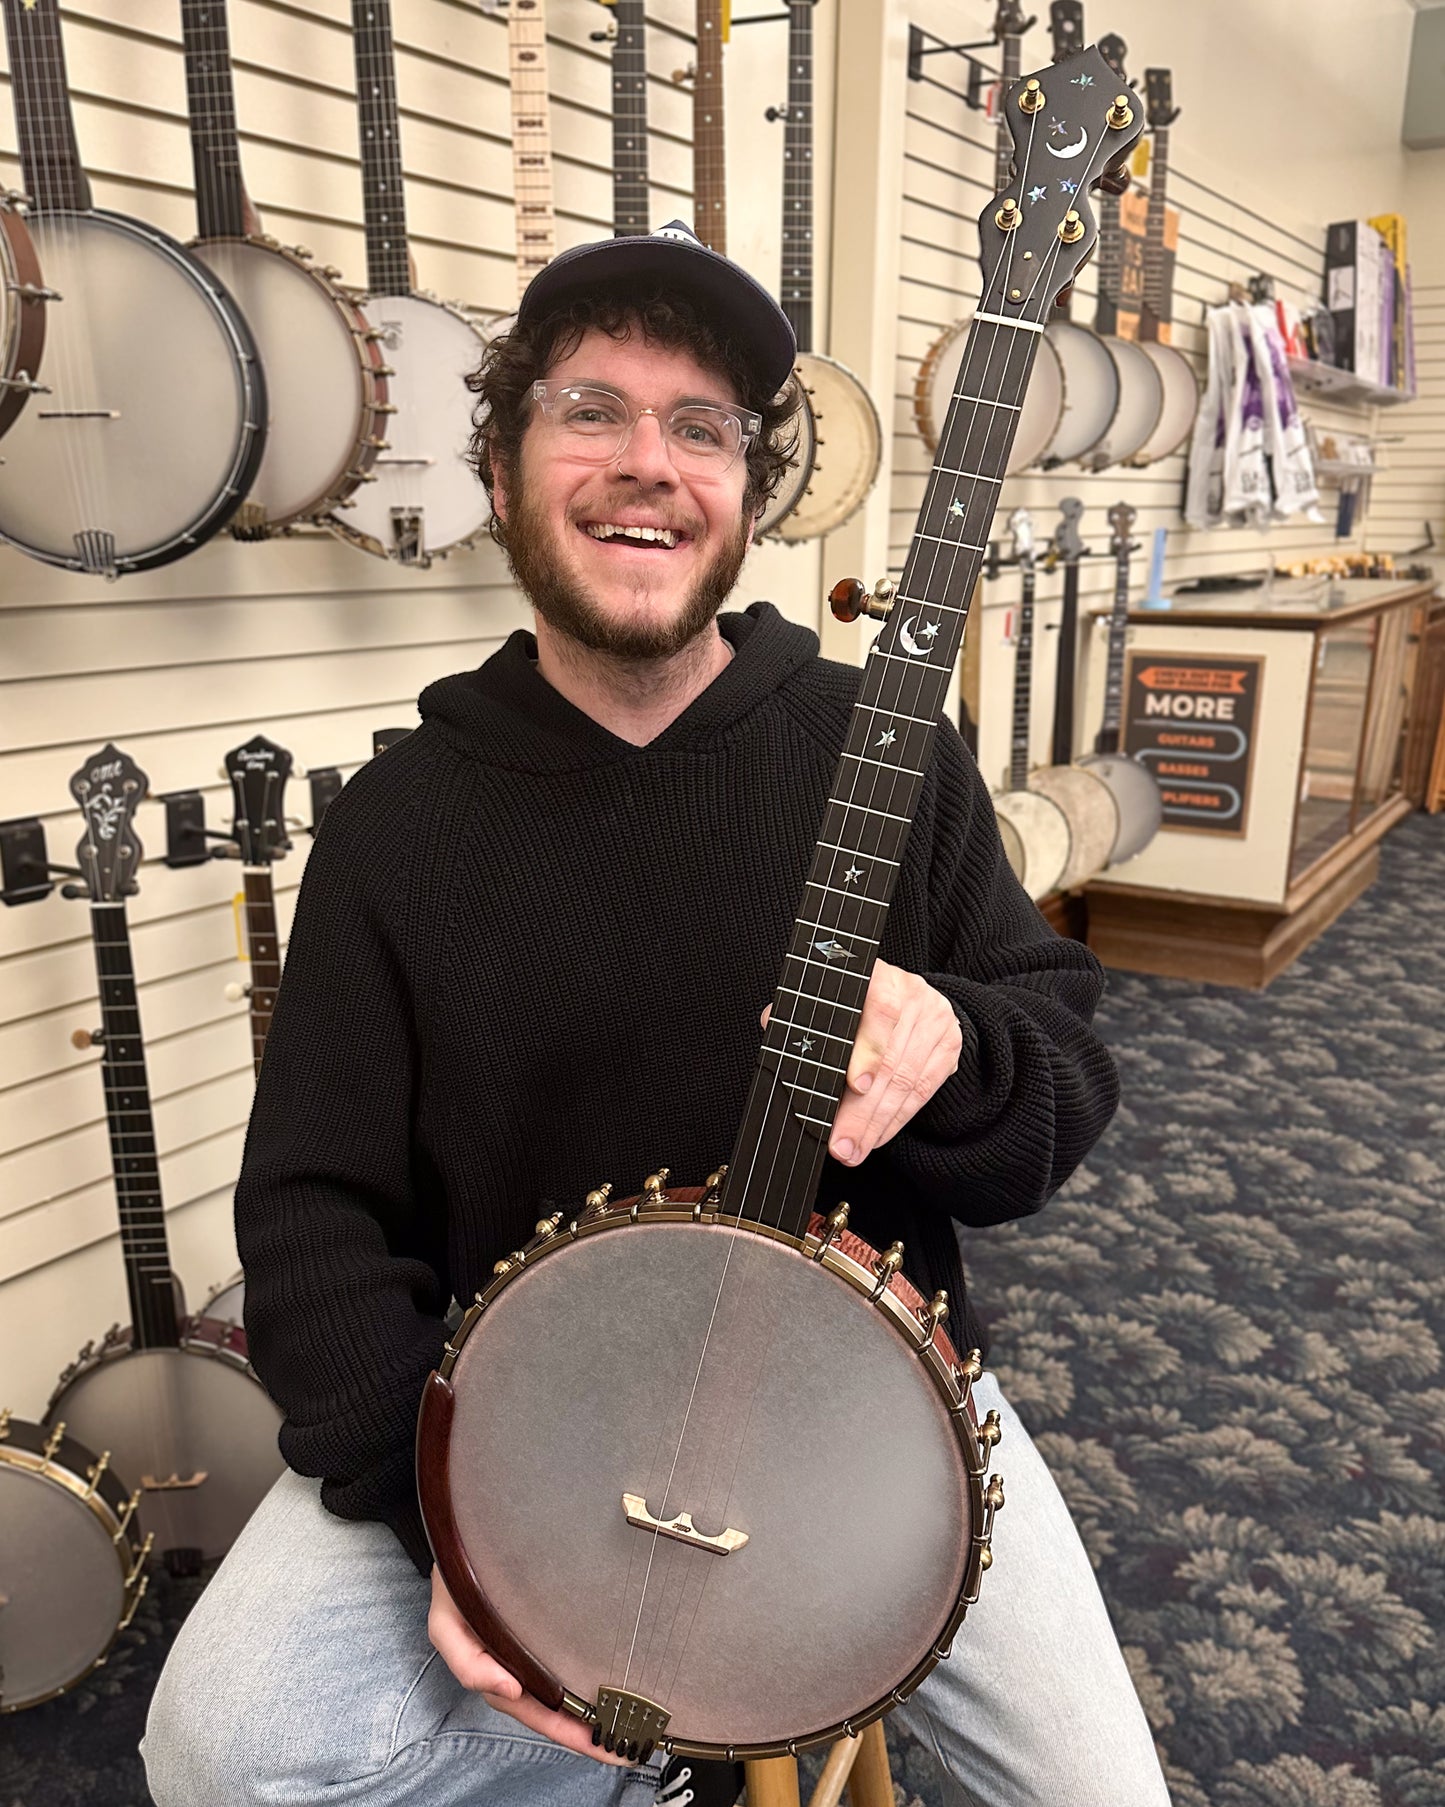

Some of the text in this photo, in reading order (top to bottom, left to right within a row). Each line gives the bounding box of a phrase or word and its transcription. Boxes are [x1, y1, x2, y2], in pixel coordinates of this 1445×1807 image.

[1145, 693, 1235, 720] MORE
[1158, 733, 1215, 747] GUITARS
[1158, 762, 1208, 776] BASSES
[1162, 792, 1220, 806] PLIFIERS
